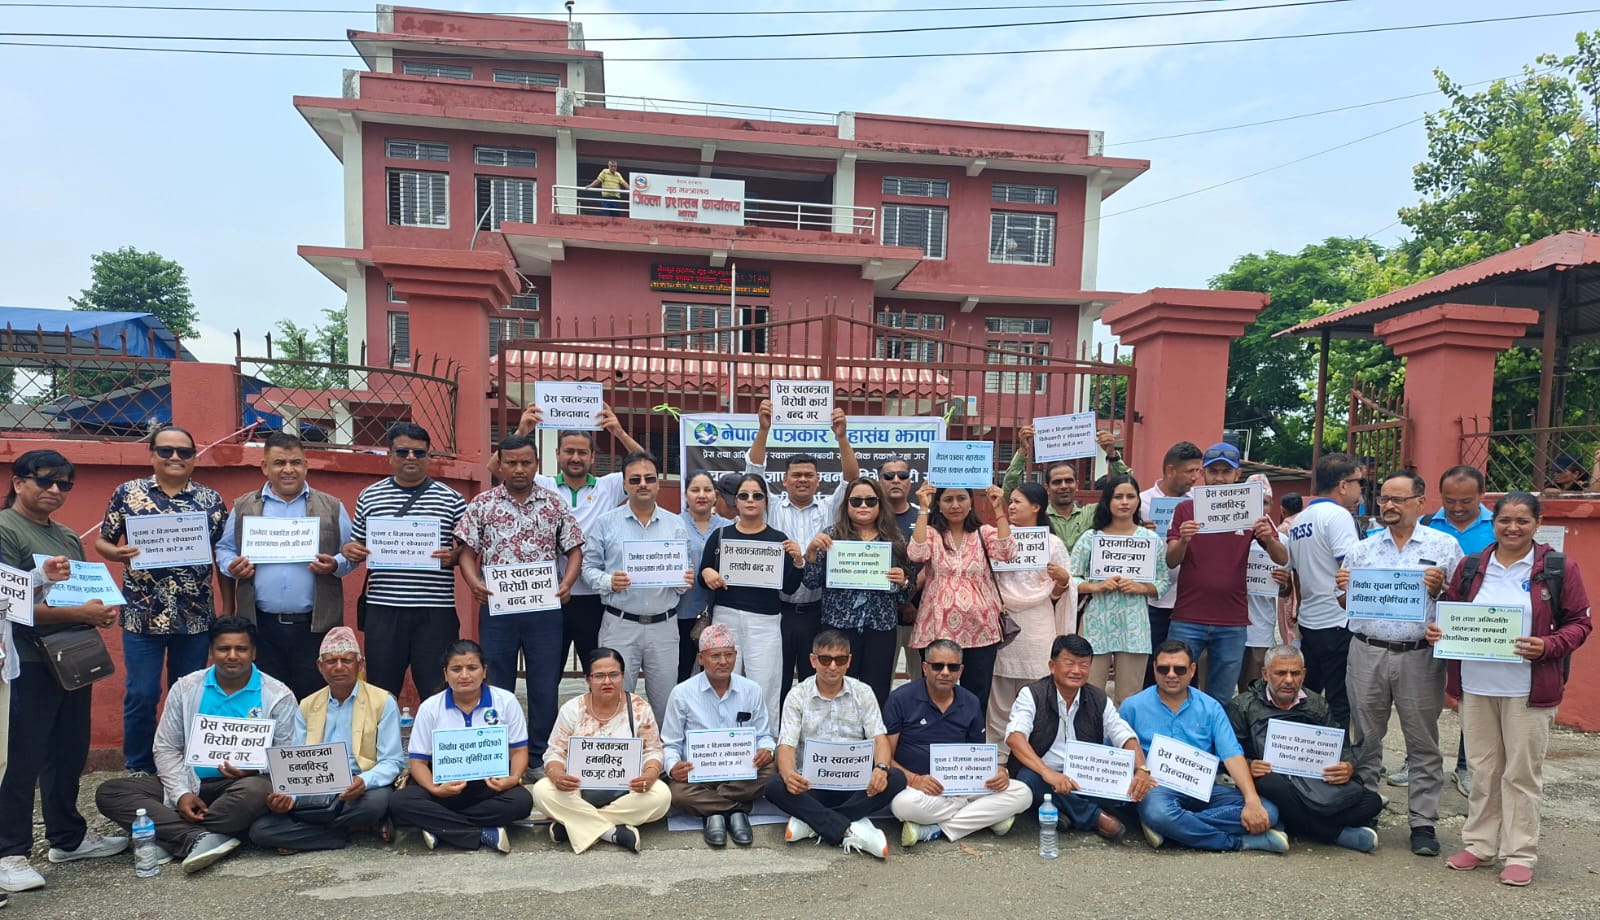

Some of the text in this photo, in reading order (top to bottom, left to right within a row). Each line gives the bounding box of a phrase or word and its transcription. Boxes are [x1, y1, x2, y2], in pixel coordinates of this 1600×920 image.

[633, 190, 741, 212] जिल्ला प्रशासन कार्यालय
[776, 383, 830, 394] प्रेस स्वतन्त्रता
[544, 394, 599, 404] प्रेस स्वतन्त्रता
[781, 396, 828, 406] विरोधी कार्य
[787, 411, 819, 419] बन्द गर
[773, 429, 830, 443] पत्रकार
[847, 427, 890, 443] हासंघ
[703, 450, 715, 459] प्रेस
[1205, 487, 1250, 498] प्रेस स्वतन्त्रता
[1013, 531, 1046, 540] वतन्त्रता
[1026, 541, 1045, 551] कार्य
[1099, 538, 1151, 549] प्रेसमाथिको
[1024, 556, 1037, 564] गर
[1101, 550, 1146, 562] नियन्त्रण
[492, 566, 553, 580] प्रेस स्वतन्त्रता
[765, 565, 775, 573] गर
[1103, 565, 1141, 575] बन्द गर
[0, 568, 29, 587] न्त्रता
[499, 578, 552, 593] विरोधी कार्य
[1373, 582, 1392, 591] सूचना
[0, 585, 25, 600] कार्य
[507, 594, 544, 606] बन्द गर
[1352, 594, 1377, 603] अधिकार
[200, 717, 271, 733] प्रेस स्वतन्त्रता
[203, 732, 266, 747] विरोधी कार्य
[581, 739, 629, 751] प्रेस स्वतन्त्रता
[208, 750, 251, 761] बन्द गर
[280, 747, 332, 759] प्रेस स्वतन्त्रता
[812, 753, 870, 764] प्रेस स्वतन्त्रता
[1158, 747, 1212, 775] प्रेस स्वतन्त्रता
